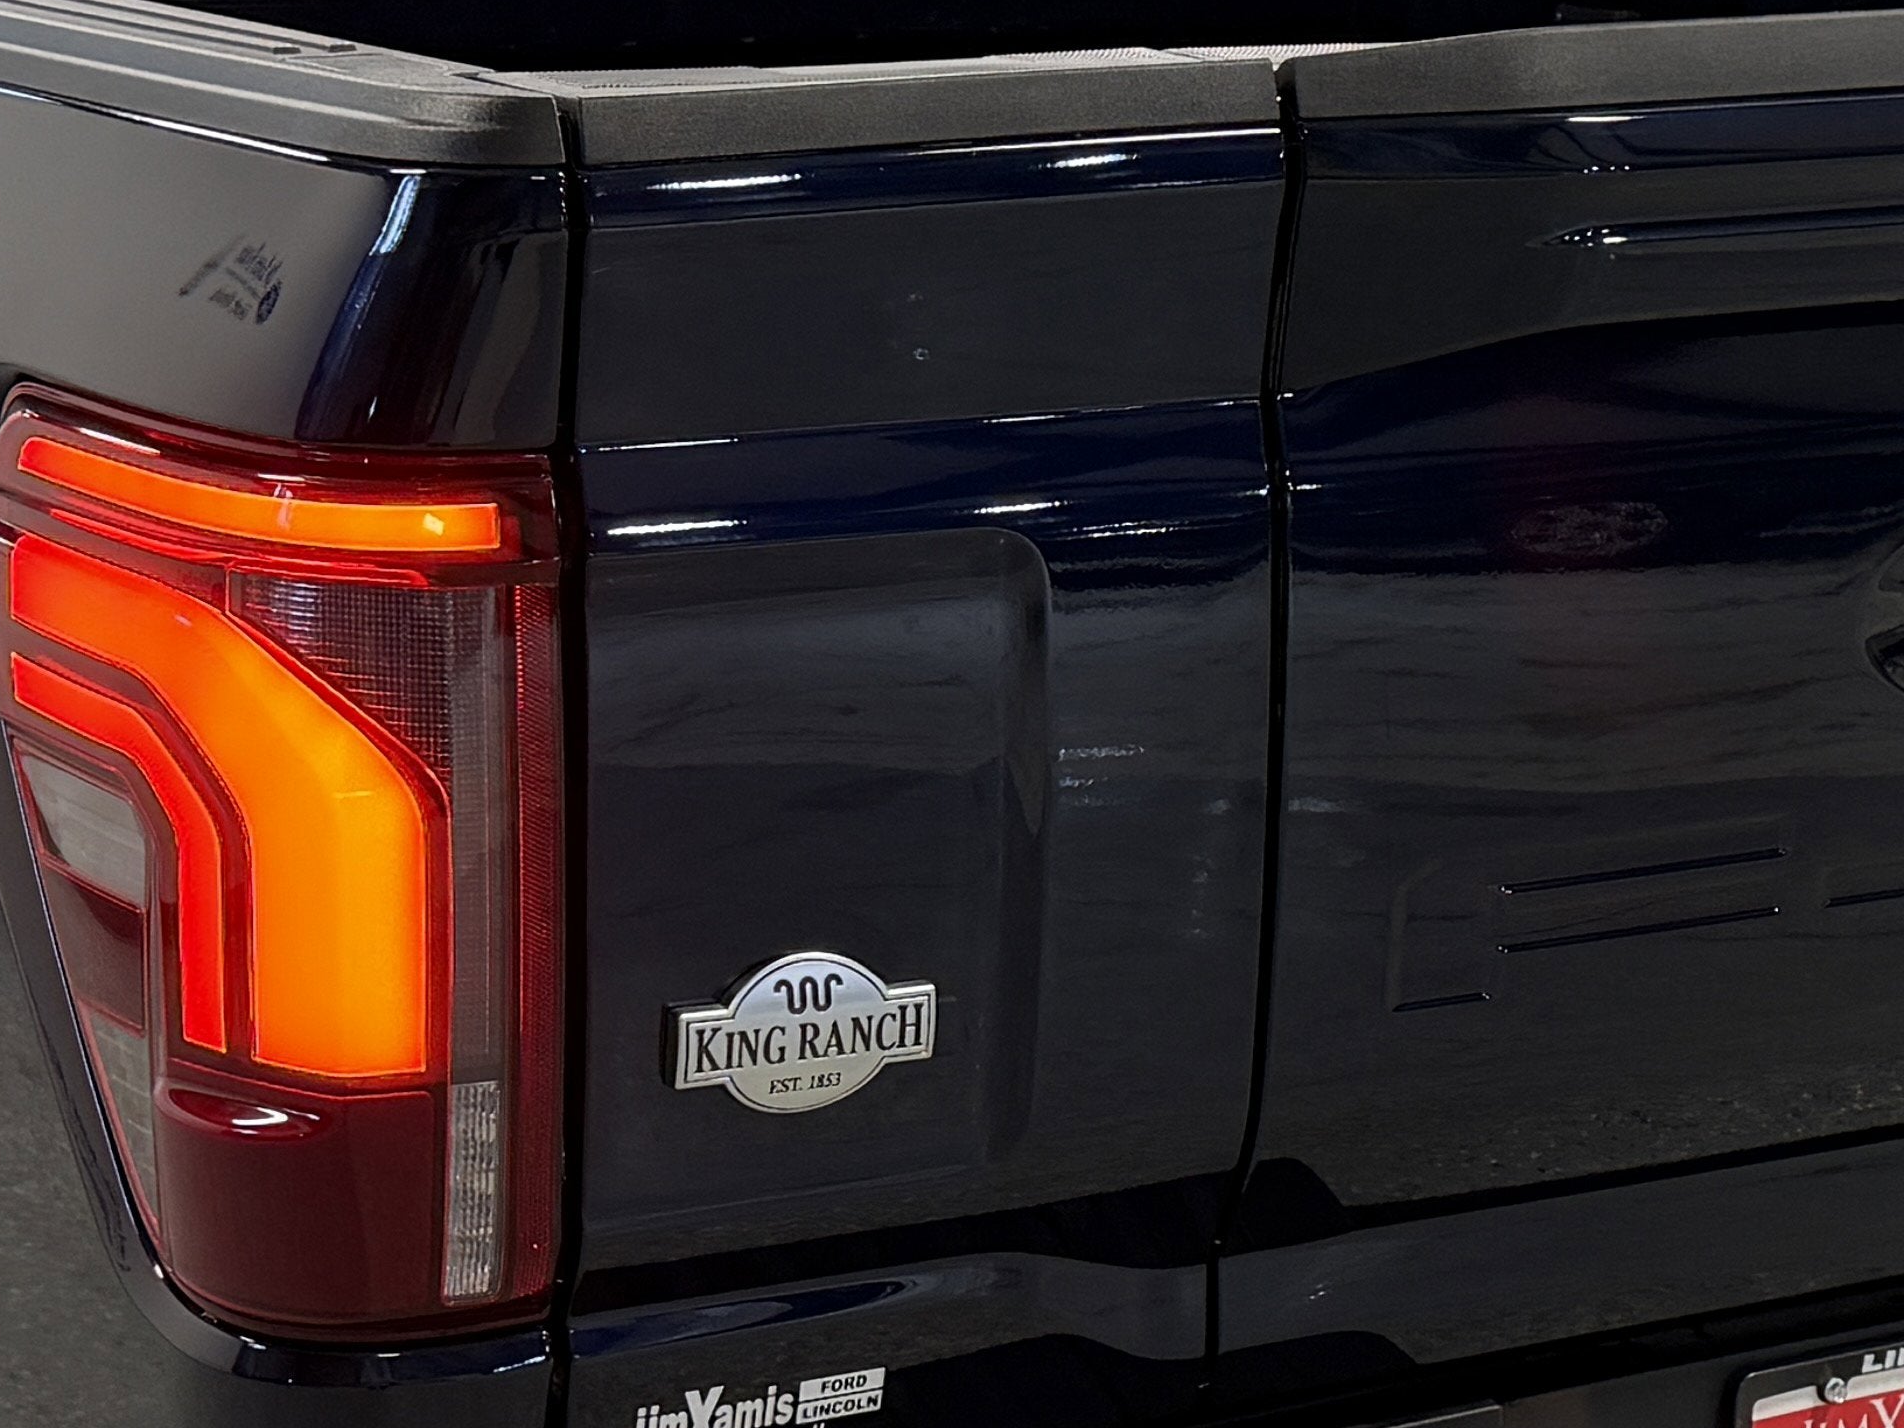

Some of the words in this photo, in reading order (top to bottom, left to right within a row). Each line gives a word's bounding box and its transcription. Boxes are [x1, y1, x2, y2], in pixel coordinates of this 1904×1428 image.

[694, 1024, 788, 1075] KING
[797, 1002, 925, 1062] RANCH
[768, 1077, 805, 1096] EST.
[807, 1071, 843, 1091] 1853
[820, 1374, 868, 1394] FORD
[802, 1394, 880, 1420] LINCOLN
